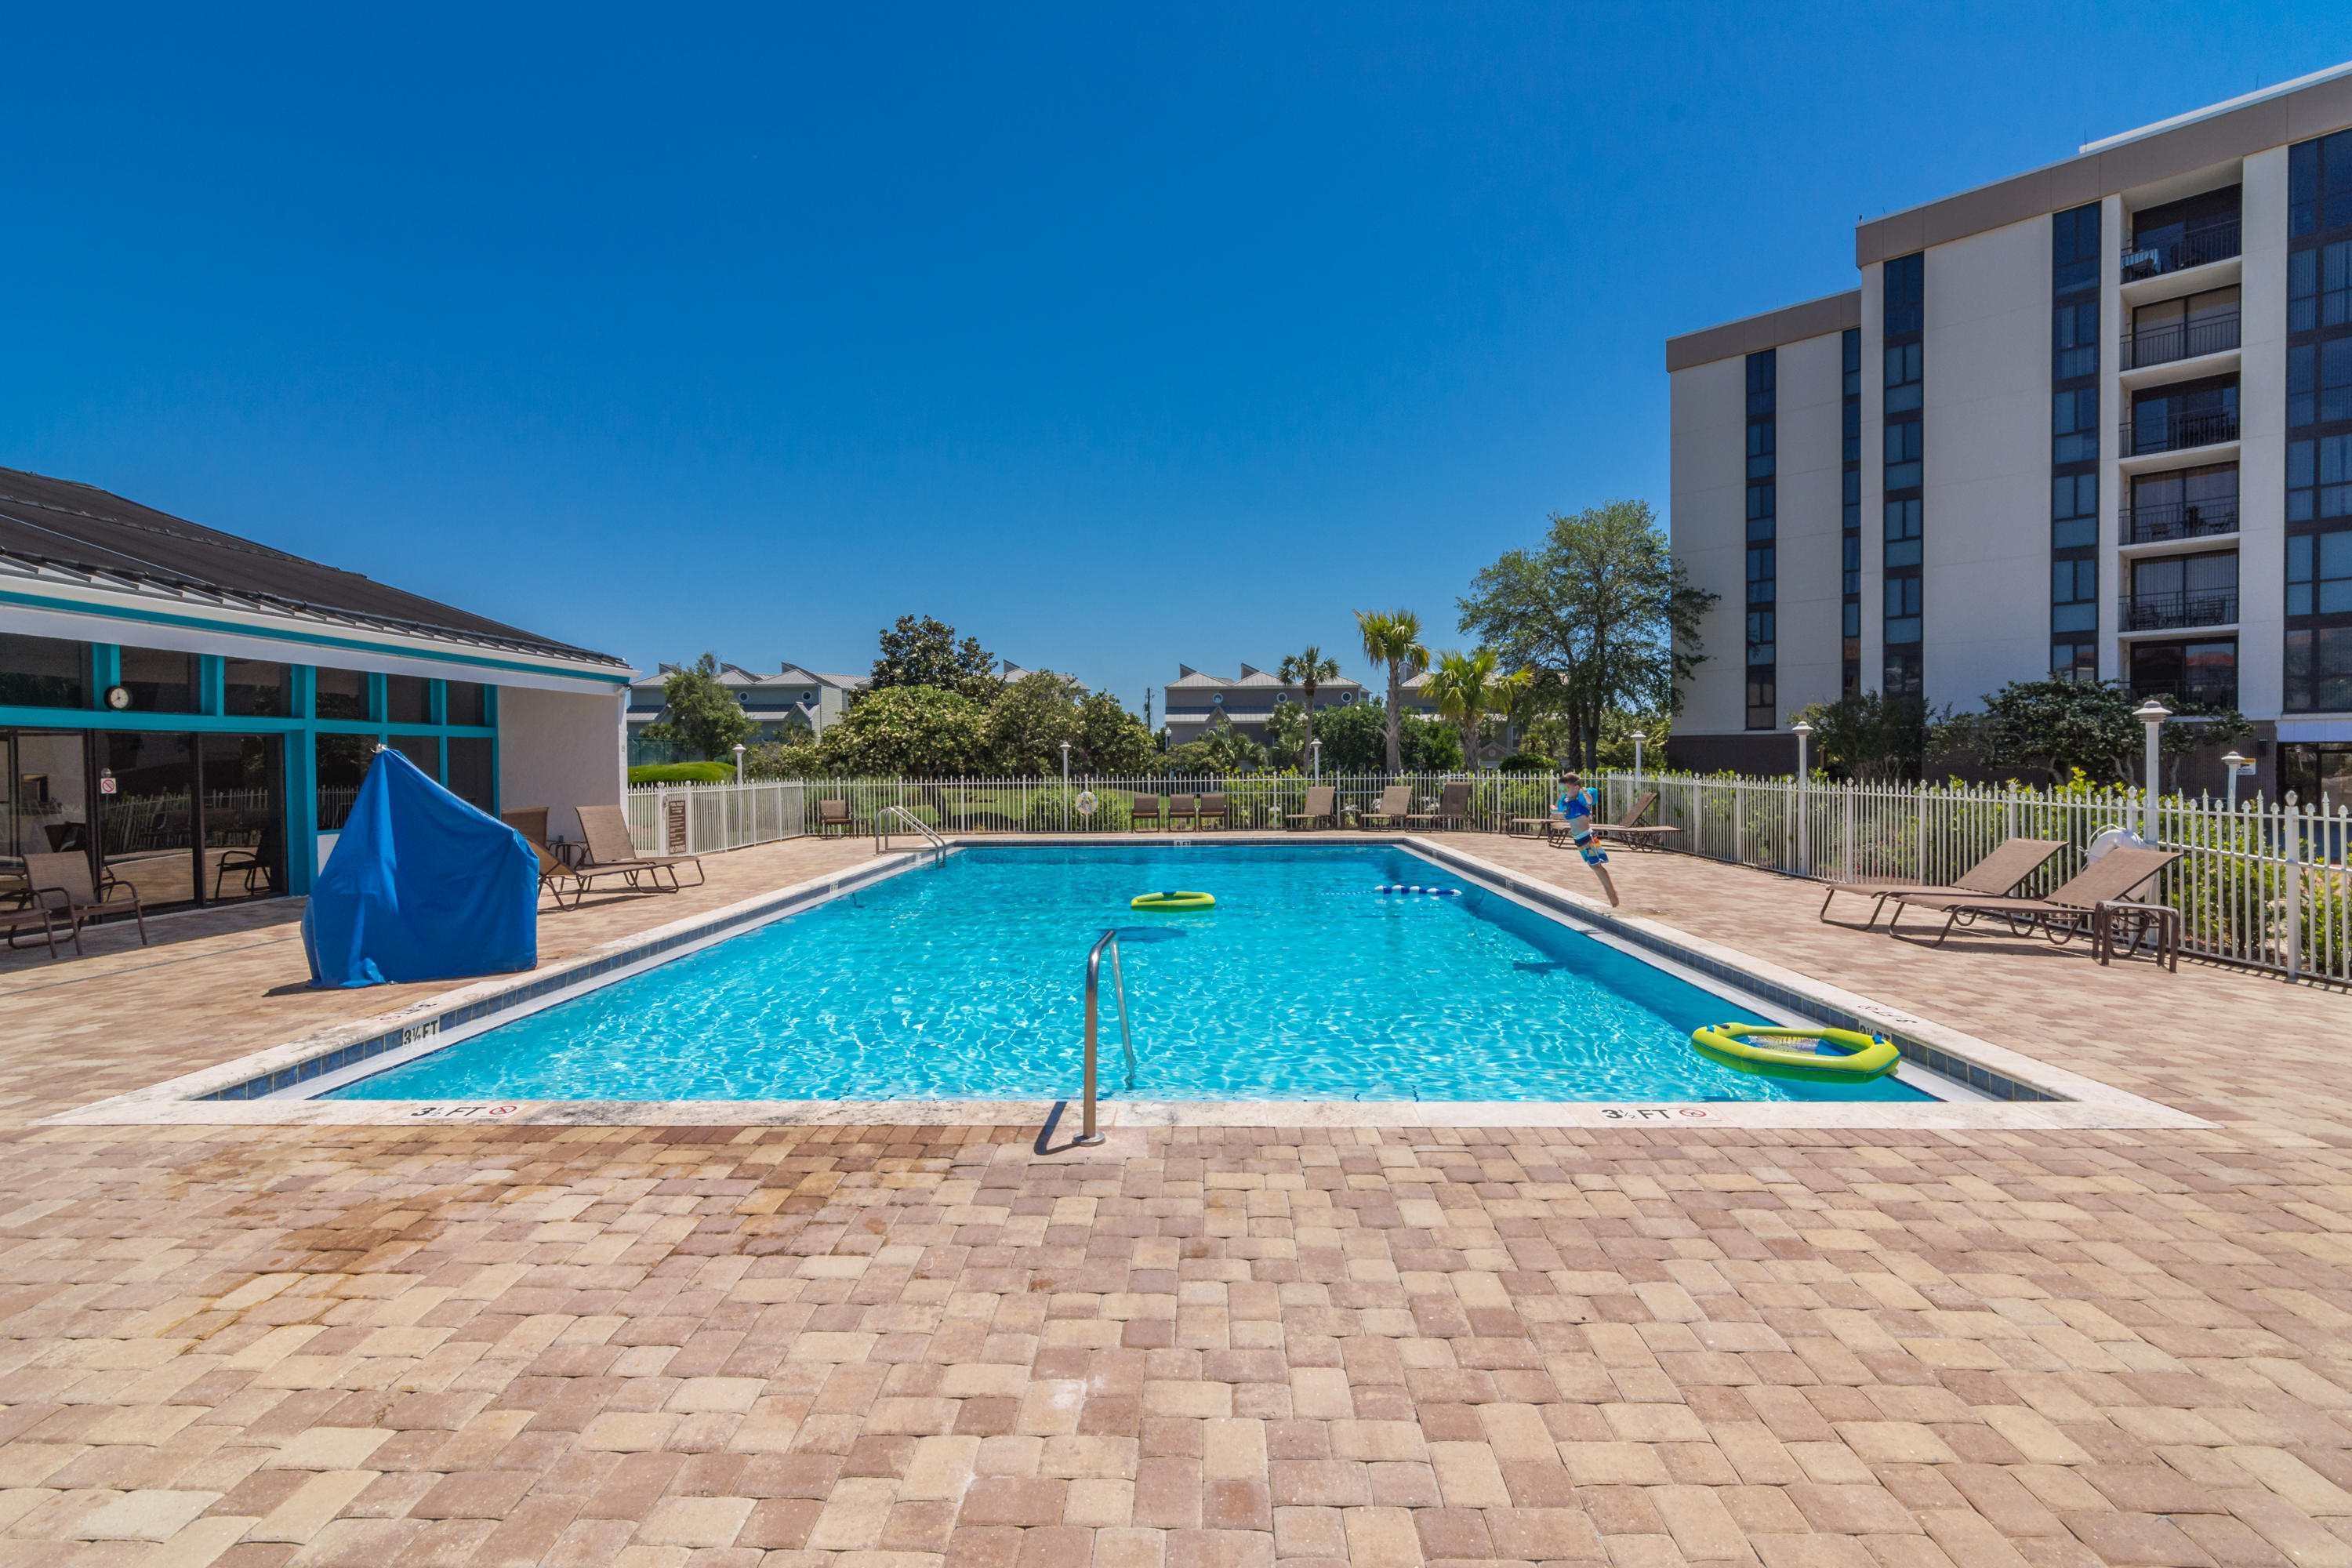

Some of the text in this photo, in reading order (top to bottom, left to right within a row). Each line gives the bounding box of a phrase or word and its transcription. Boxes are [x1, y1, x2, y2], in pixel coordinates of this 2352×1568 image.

[423, 1019, 438, 1039] FT
[444, 1106, 488, 1116] FT
[1637, 1109, 1671, 1119] FT
